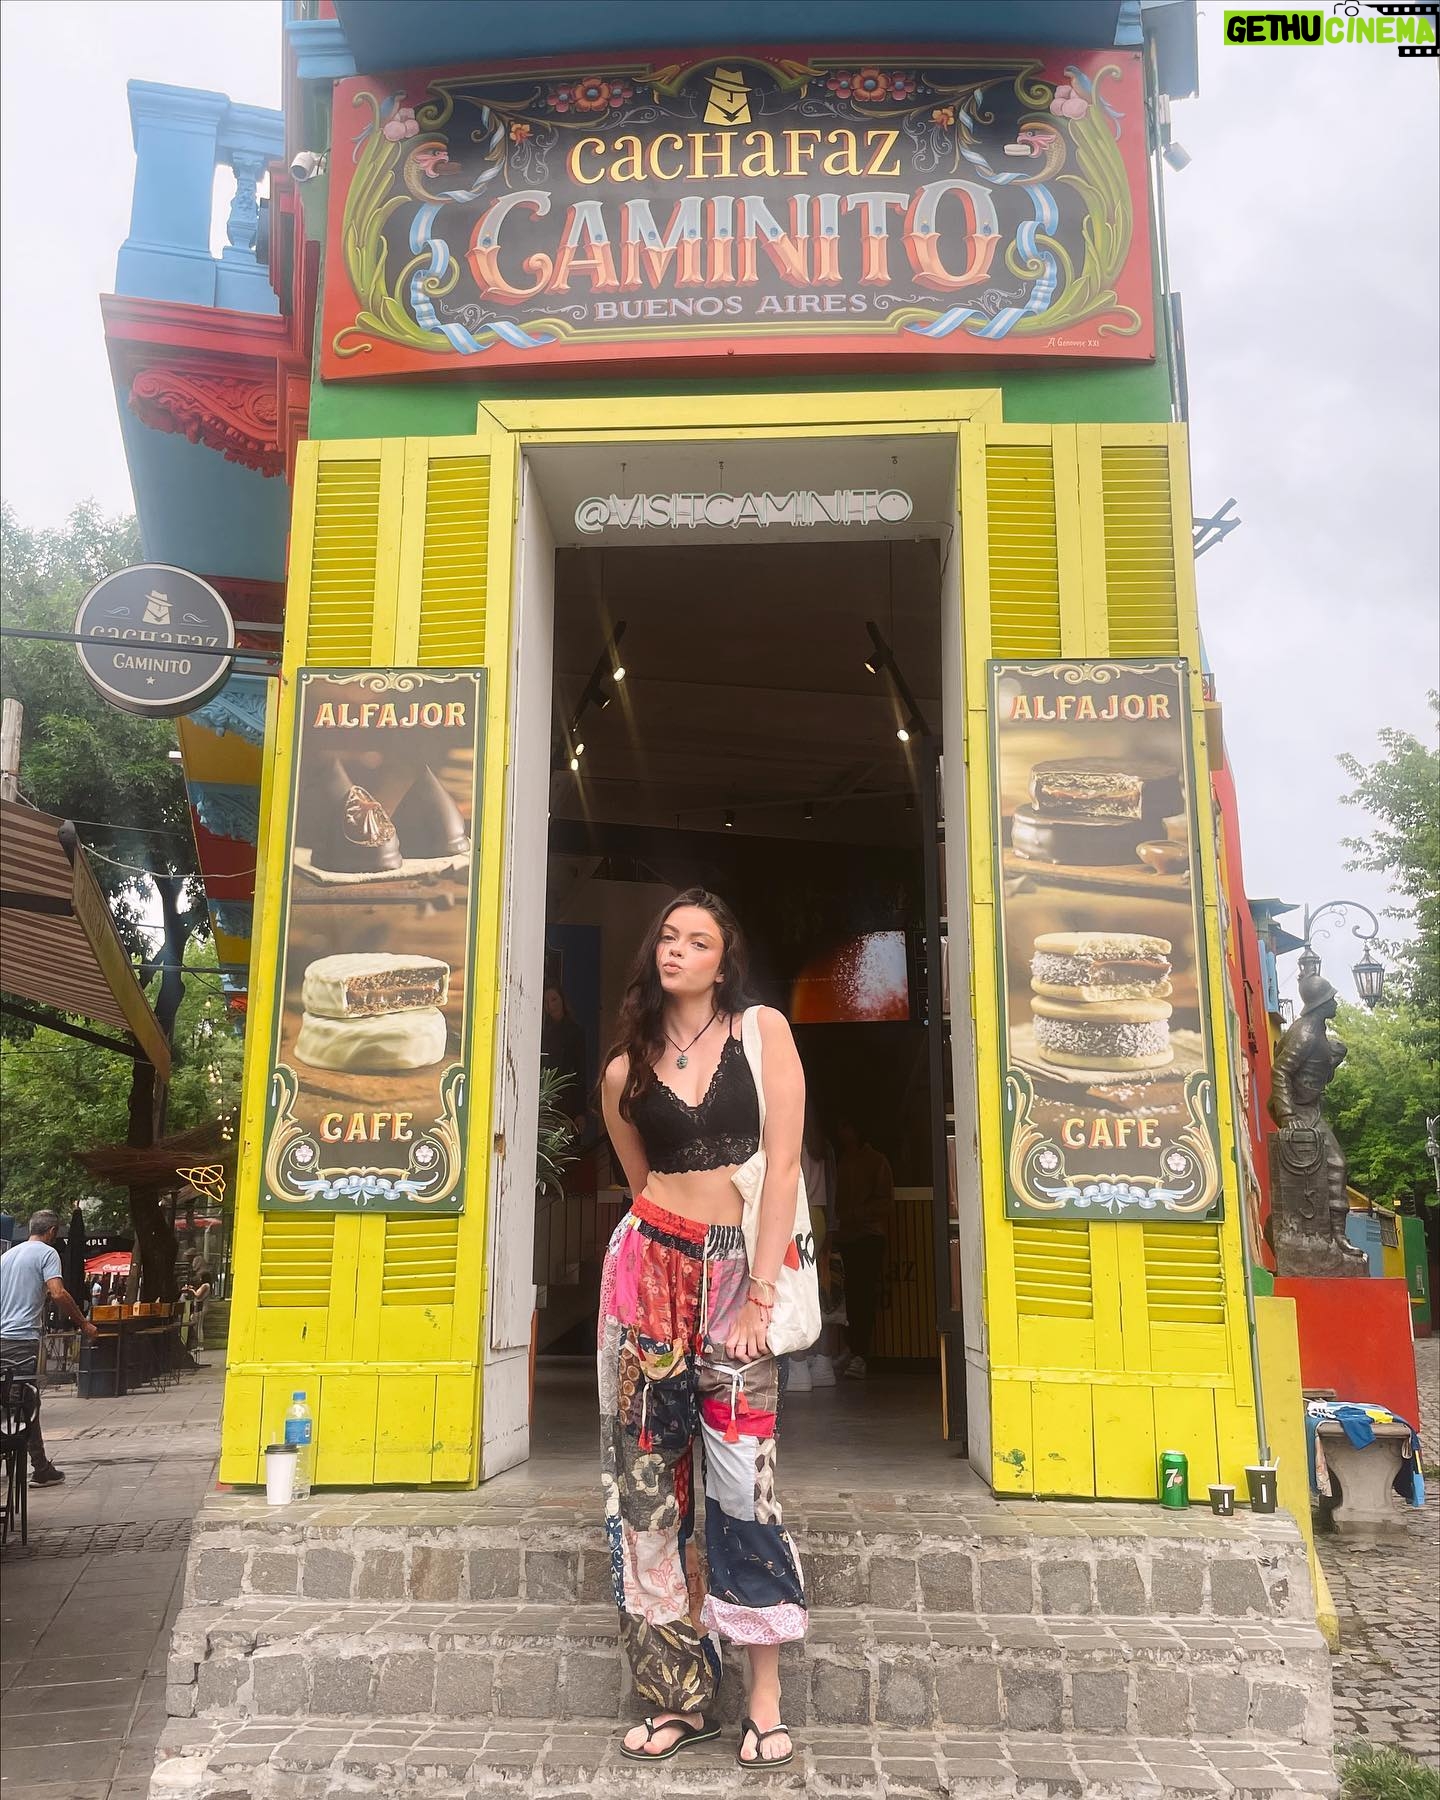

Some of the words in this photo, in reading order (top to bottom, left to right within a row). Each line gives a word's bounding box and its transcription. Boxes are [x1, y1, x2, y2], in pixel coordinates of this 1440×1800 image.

[465, 178, 1002, 305] CAMINITO
[594, 295, 743, 321] BUENOS
[756, 293, 868, 315] AIRES
[574, 489, 913, 535] @VISITCAMINITO
[112, 652, 192, 675] CAMINITO
[313, 702, 467, 728] ALFAJOR
[1010, 693, 1171, 721] ALFAJOR
[319, 1112, 414, 1143] CAFE
[1061, 1118, 1162, 1149] CAFE
